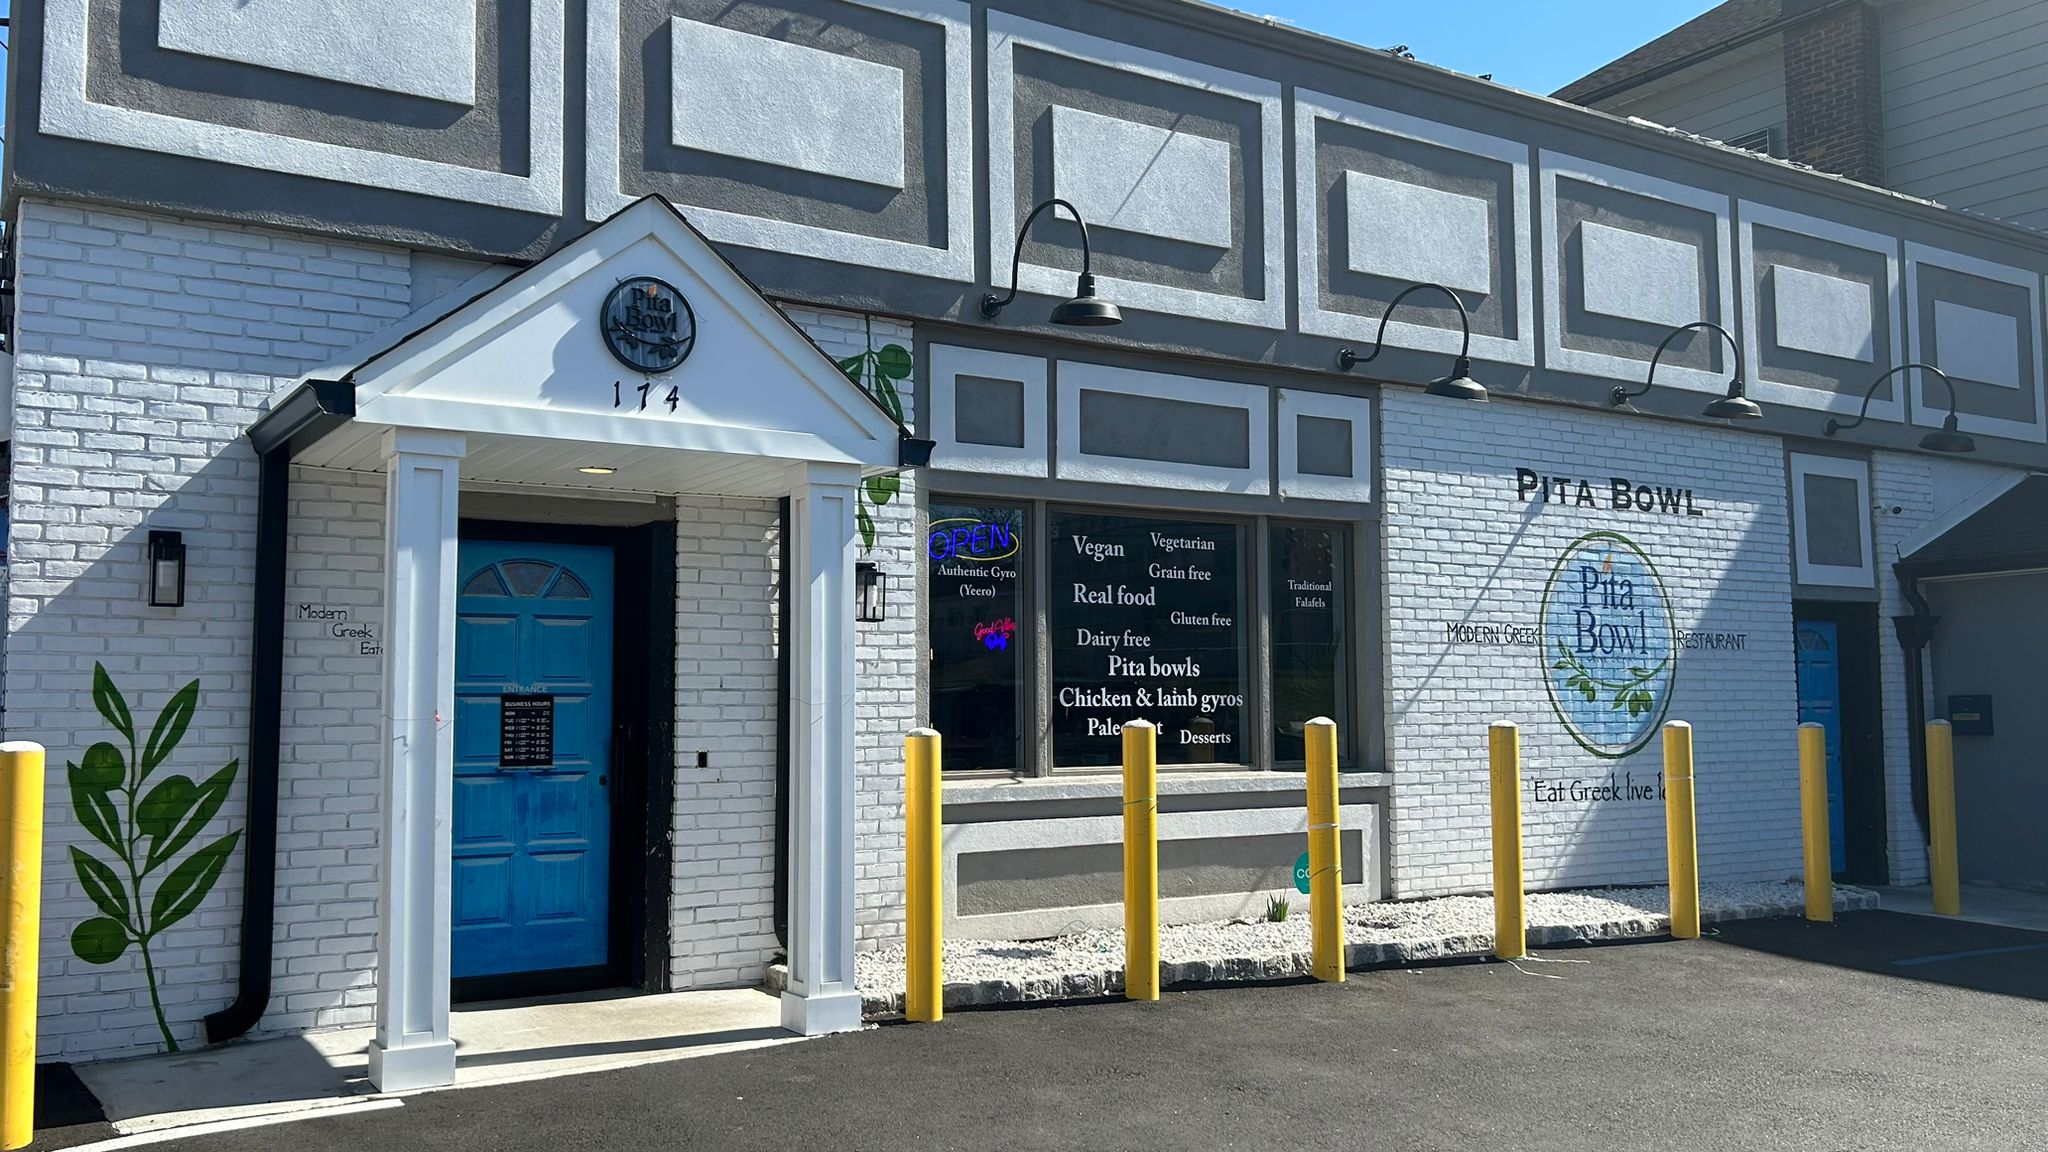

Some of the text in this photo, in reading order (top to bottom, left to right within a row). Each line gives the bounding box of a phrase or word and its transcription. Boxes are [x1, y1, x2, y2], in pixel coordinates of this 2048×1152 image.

[630, 286, 672, 313] Pita
[625, 304, 678, 333] Bowl
[613, 380, 680, 413] 174
[1515, 467, 1704, 517] PITA BOWL
[929, 521, 1010, 559] OPEN
[1072, 534, 1125, 562] Vegan
[1150, 532, 1216, 552] Vegetarian
[937, 564, 1017, 581] Authentic Gyro
[1148, 563, 1212, 581] Grain free
[959, 584, 996, 598] (Yeero)
[1073, 583, 1156, 606] Real food
[1287, 579, 1332, 591] Traditional
[1579, 566, 1634, 611] Pita
[299, 604, 348, 620] Modern
[1295, 596, 1326, 608] Falafels
[332, 623, 374, 638] Greek
[1170, 611, 1232, 627] Gluten free
[1076, 628, 1151, 652] Dairy free
[1446, 622, 1500, 645] MODERN
[1676, 630, 1748, 651] RESTAURANT
[1572, 609, 1649, 655] Bowl
[1108, 655, 1201, 678] Pita bowls
[502, 685, 548, 693] ENTRANCE
[1059, 687, 1243, 713] Chicken & lamb gyros
[1087, 717, 1123, 736] Pale
[1180, 729, 1232, 744] Desserts
[1570, 772, 1621, 802] Greek
[1626, 772, 1653, 801] live
